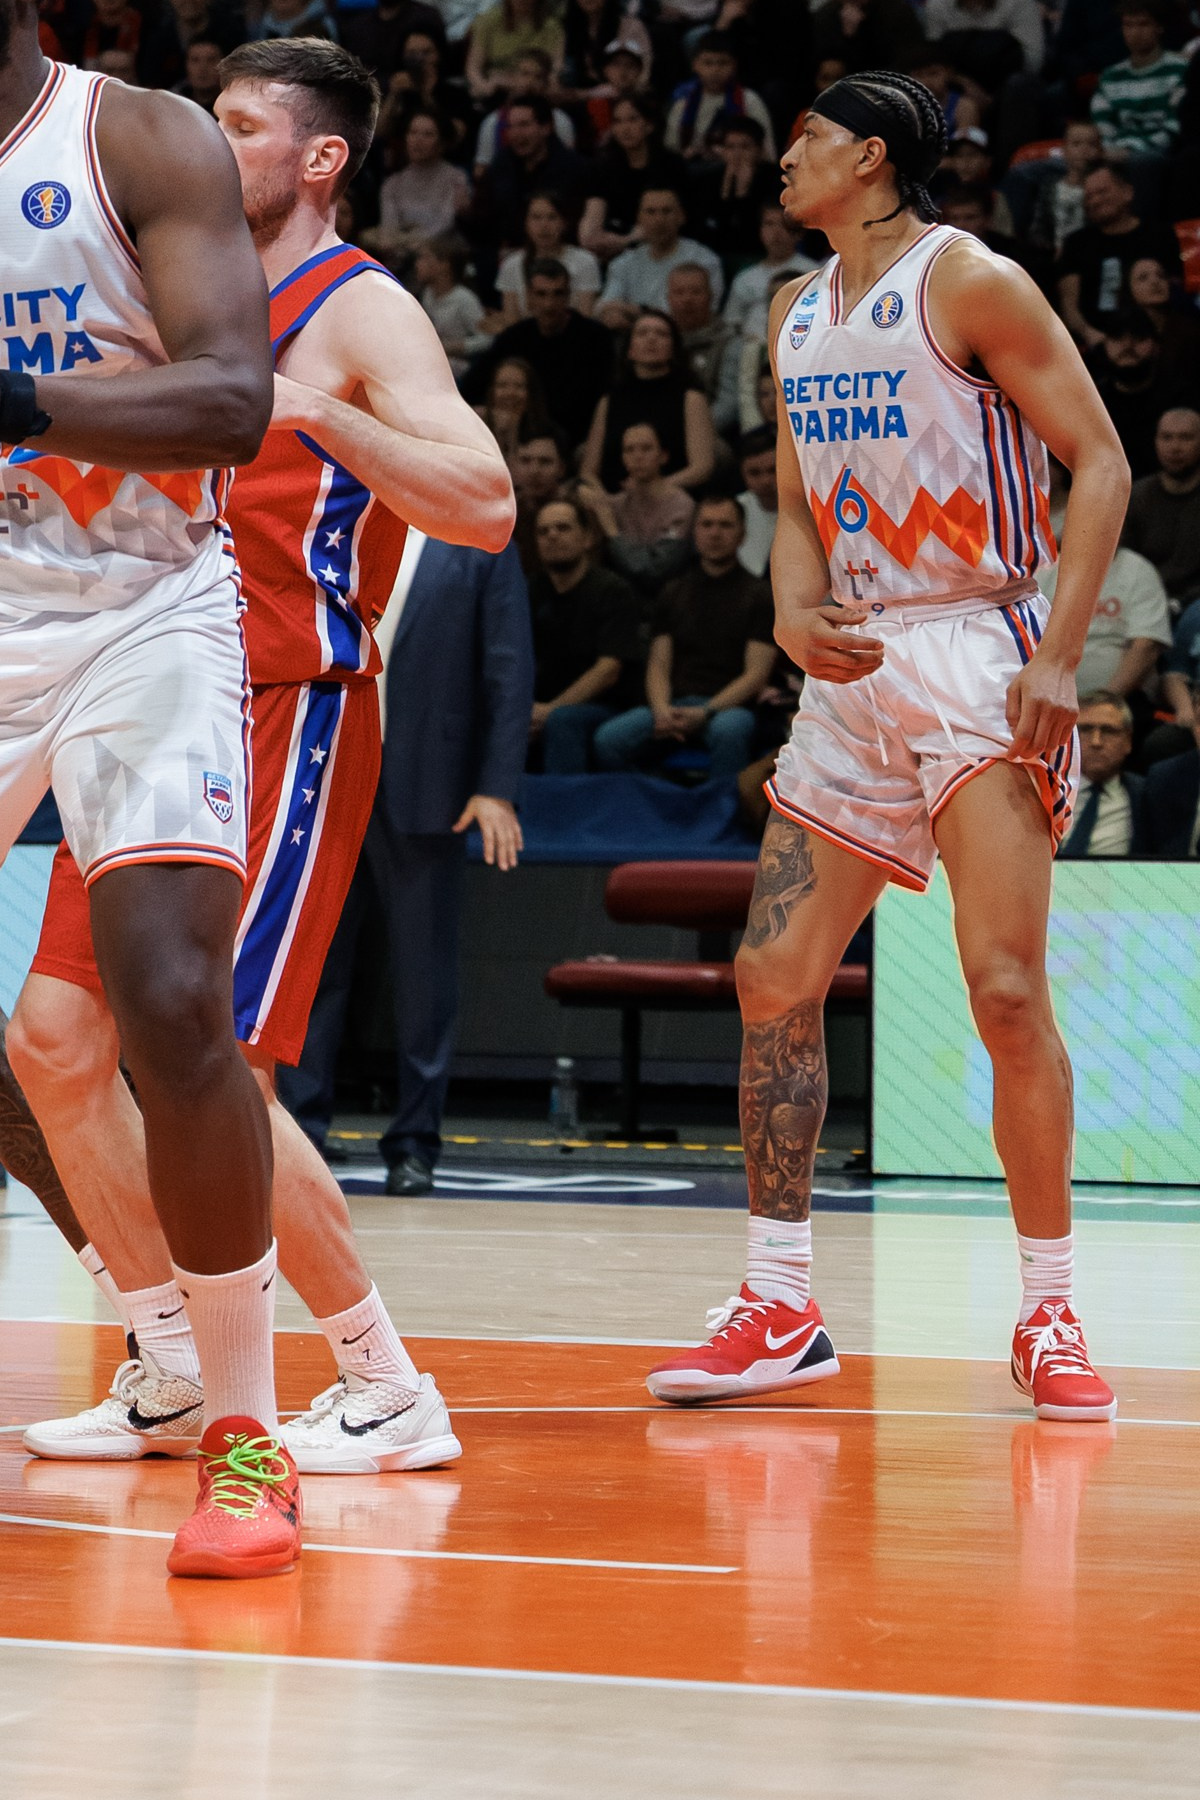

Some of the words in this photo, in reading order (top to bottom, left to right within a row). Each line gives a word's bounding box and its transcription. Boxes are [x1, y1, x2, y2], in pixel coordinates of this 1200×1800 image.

[783, 369, 908, 404] BETCITY
[788, 405, 909, 445] PARMA
[834, 467, 870, 534] 6
